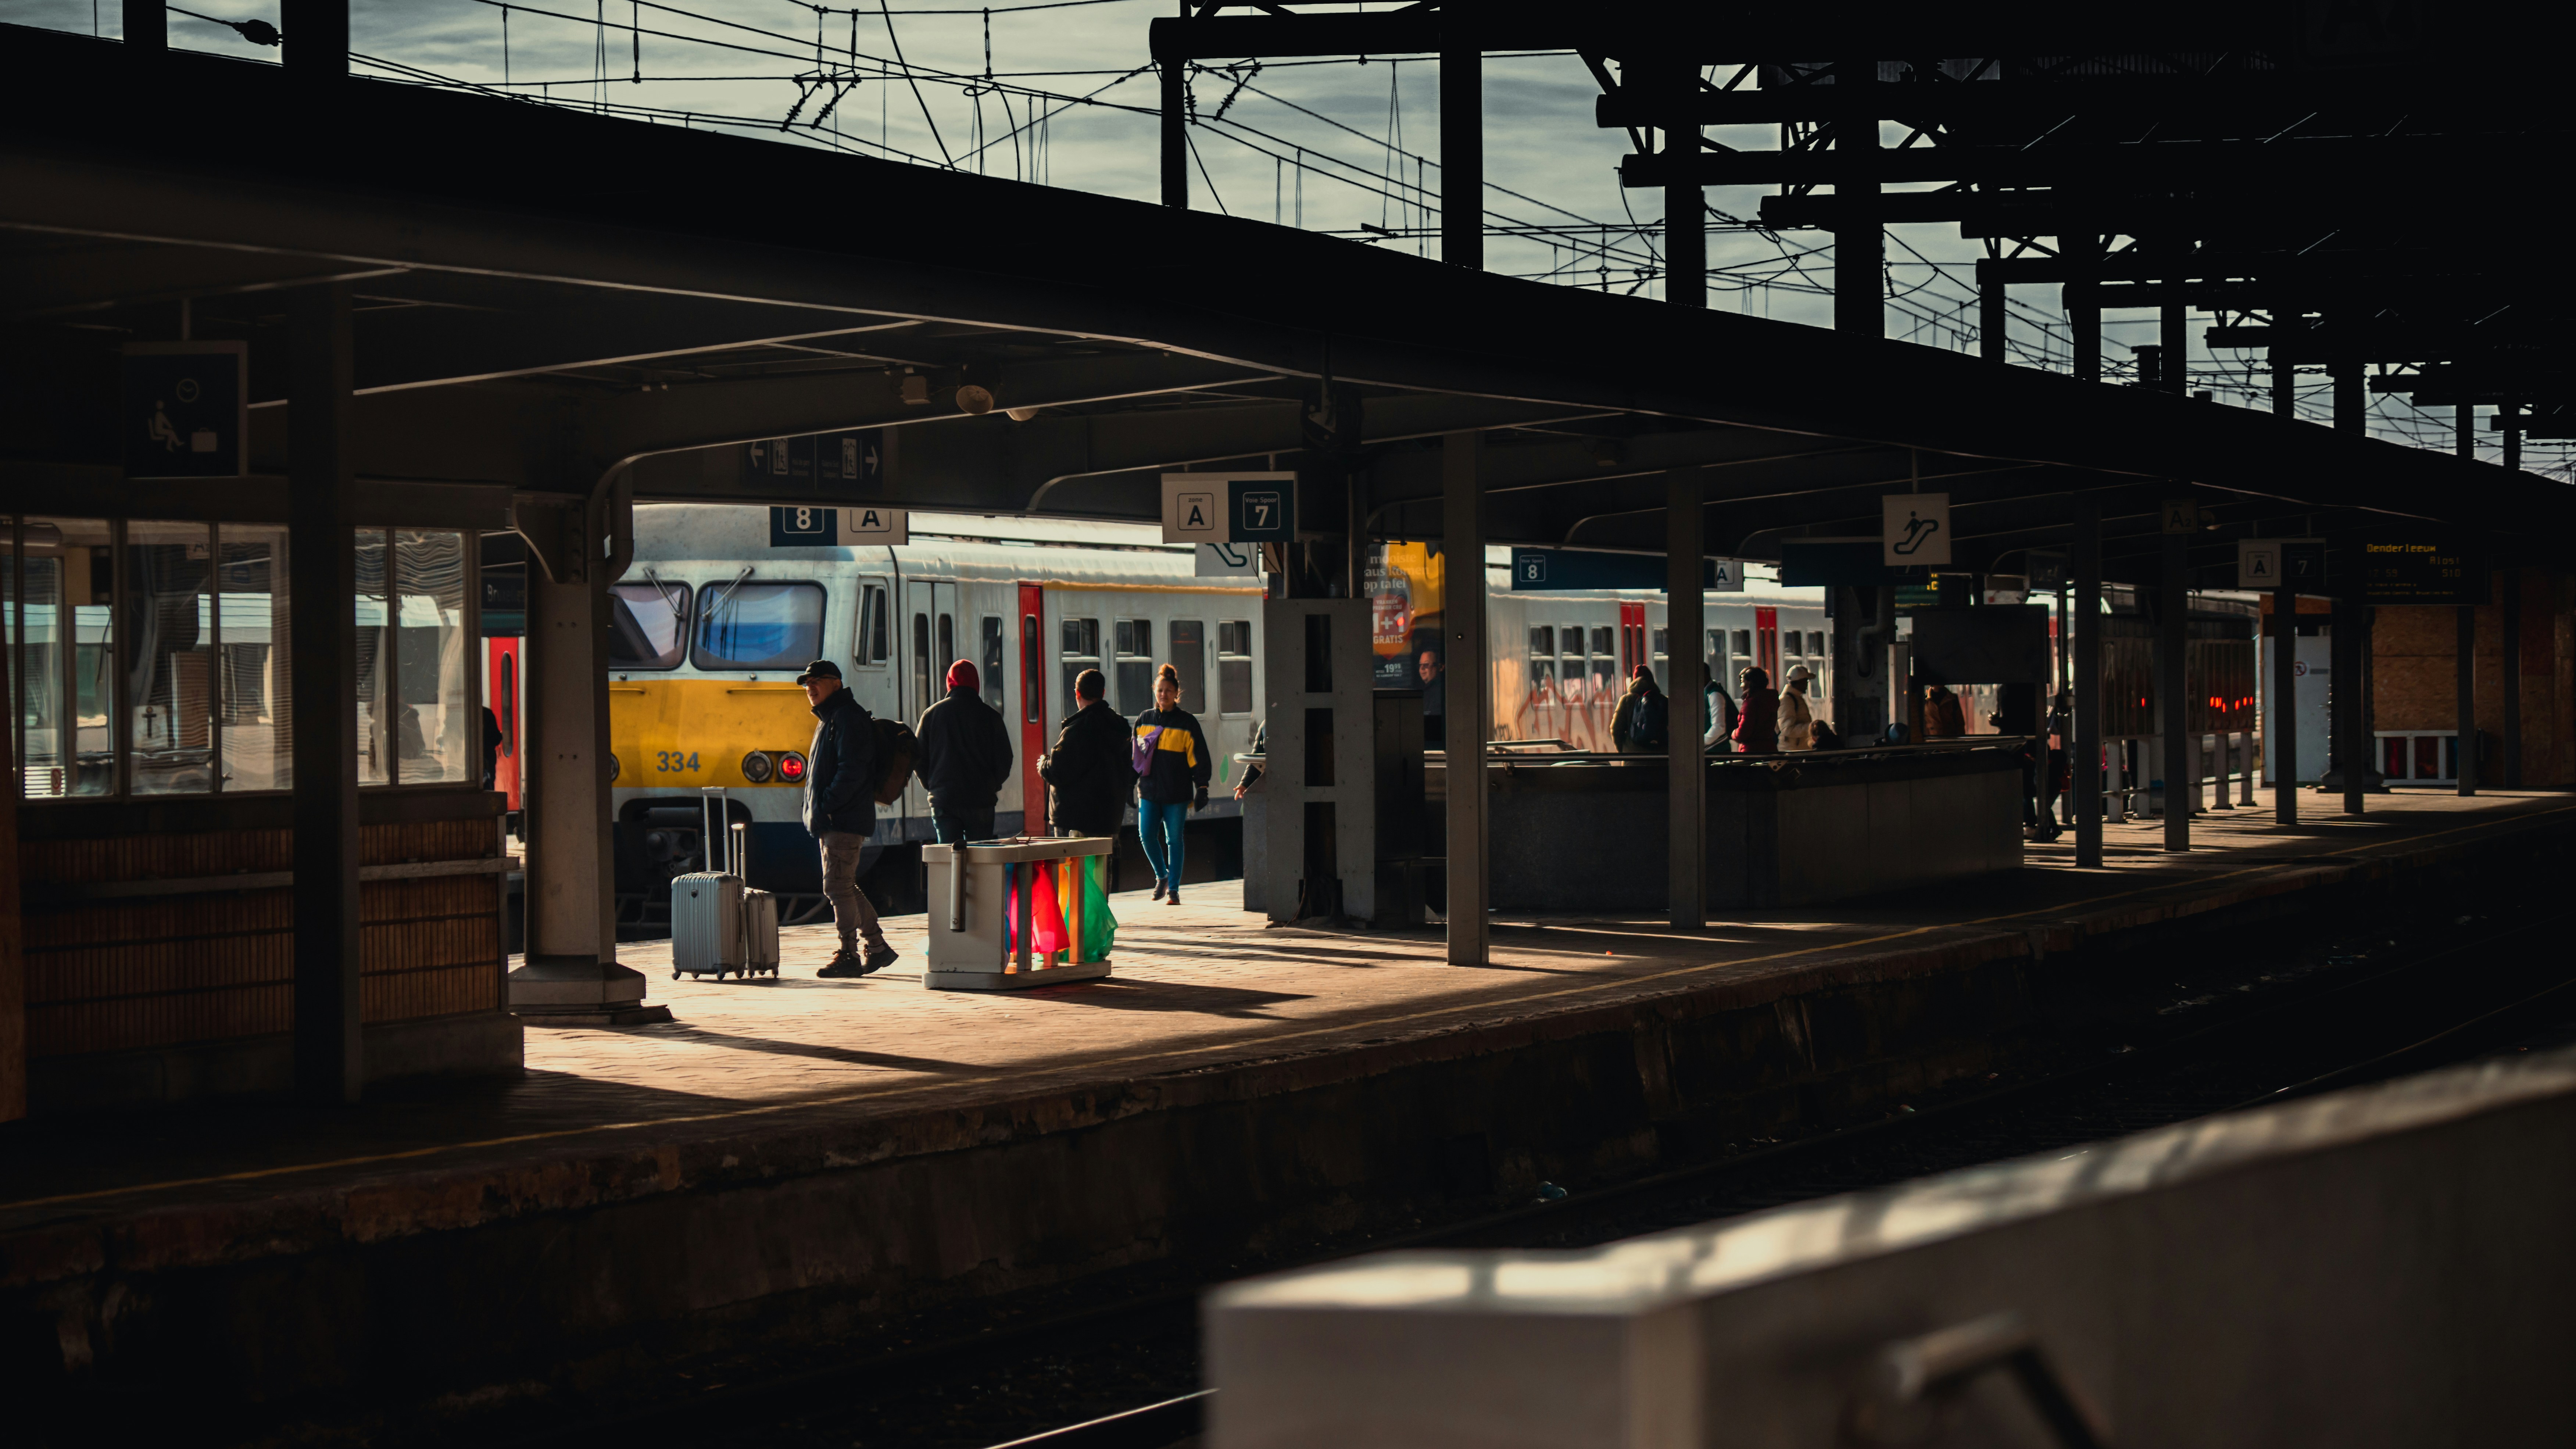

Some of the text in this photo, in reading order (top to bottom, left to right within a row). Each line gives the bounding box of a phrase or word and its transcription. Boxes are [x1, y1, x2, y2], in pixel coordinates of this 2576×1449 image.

[797, 507, 811, 529] 8
[862, 510, 881, 527] A
[1187, 505, 1204, 525] A
[1255, 505, 1268, 526] 7
[1528, 564, 1538, 579] 8
[1717, 567, 1728, 581] A
[2254, 560, 2266, 574] A
[2298, 560, 2307, 575] 7
[1364, 578, 1406, 592] op tafel
[1373, 635, 1403, 644] GRATIS
[656, 750, 701, 773] 334
